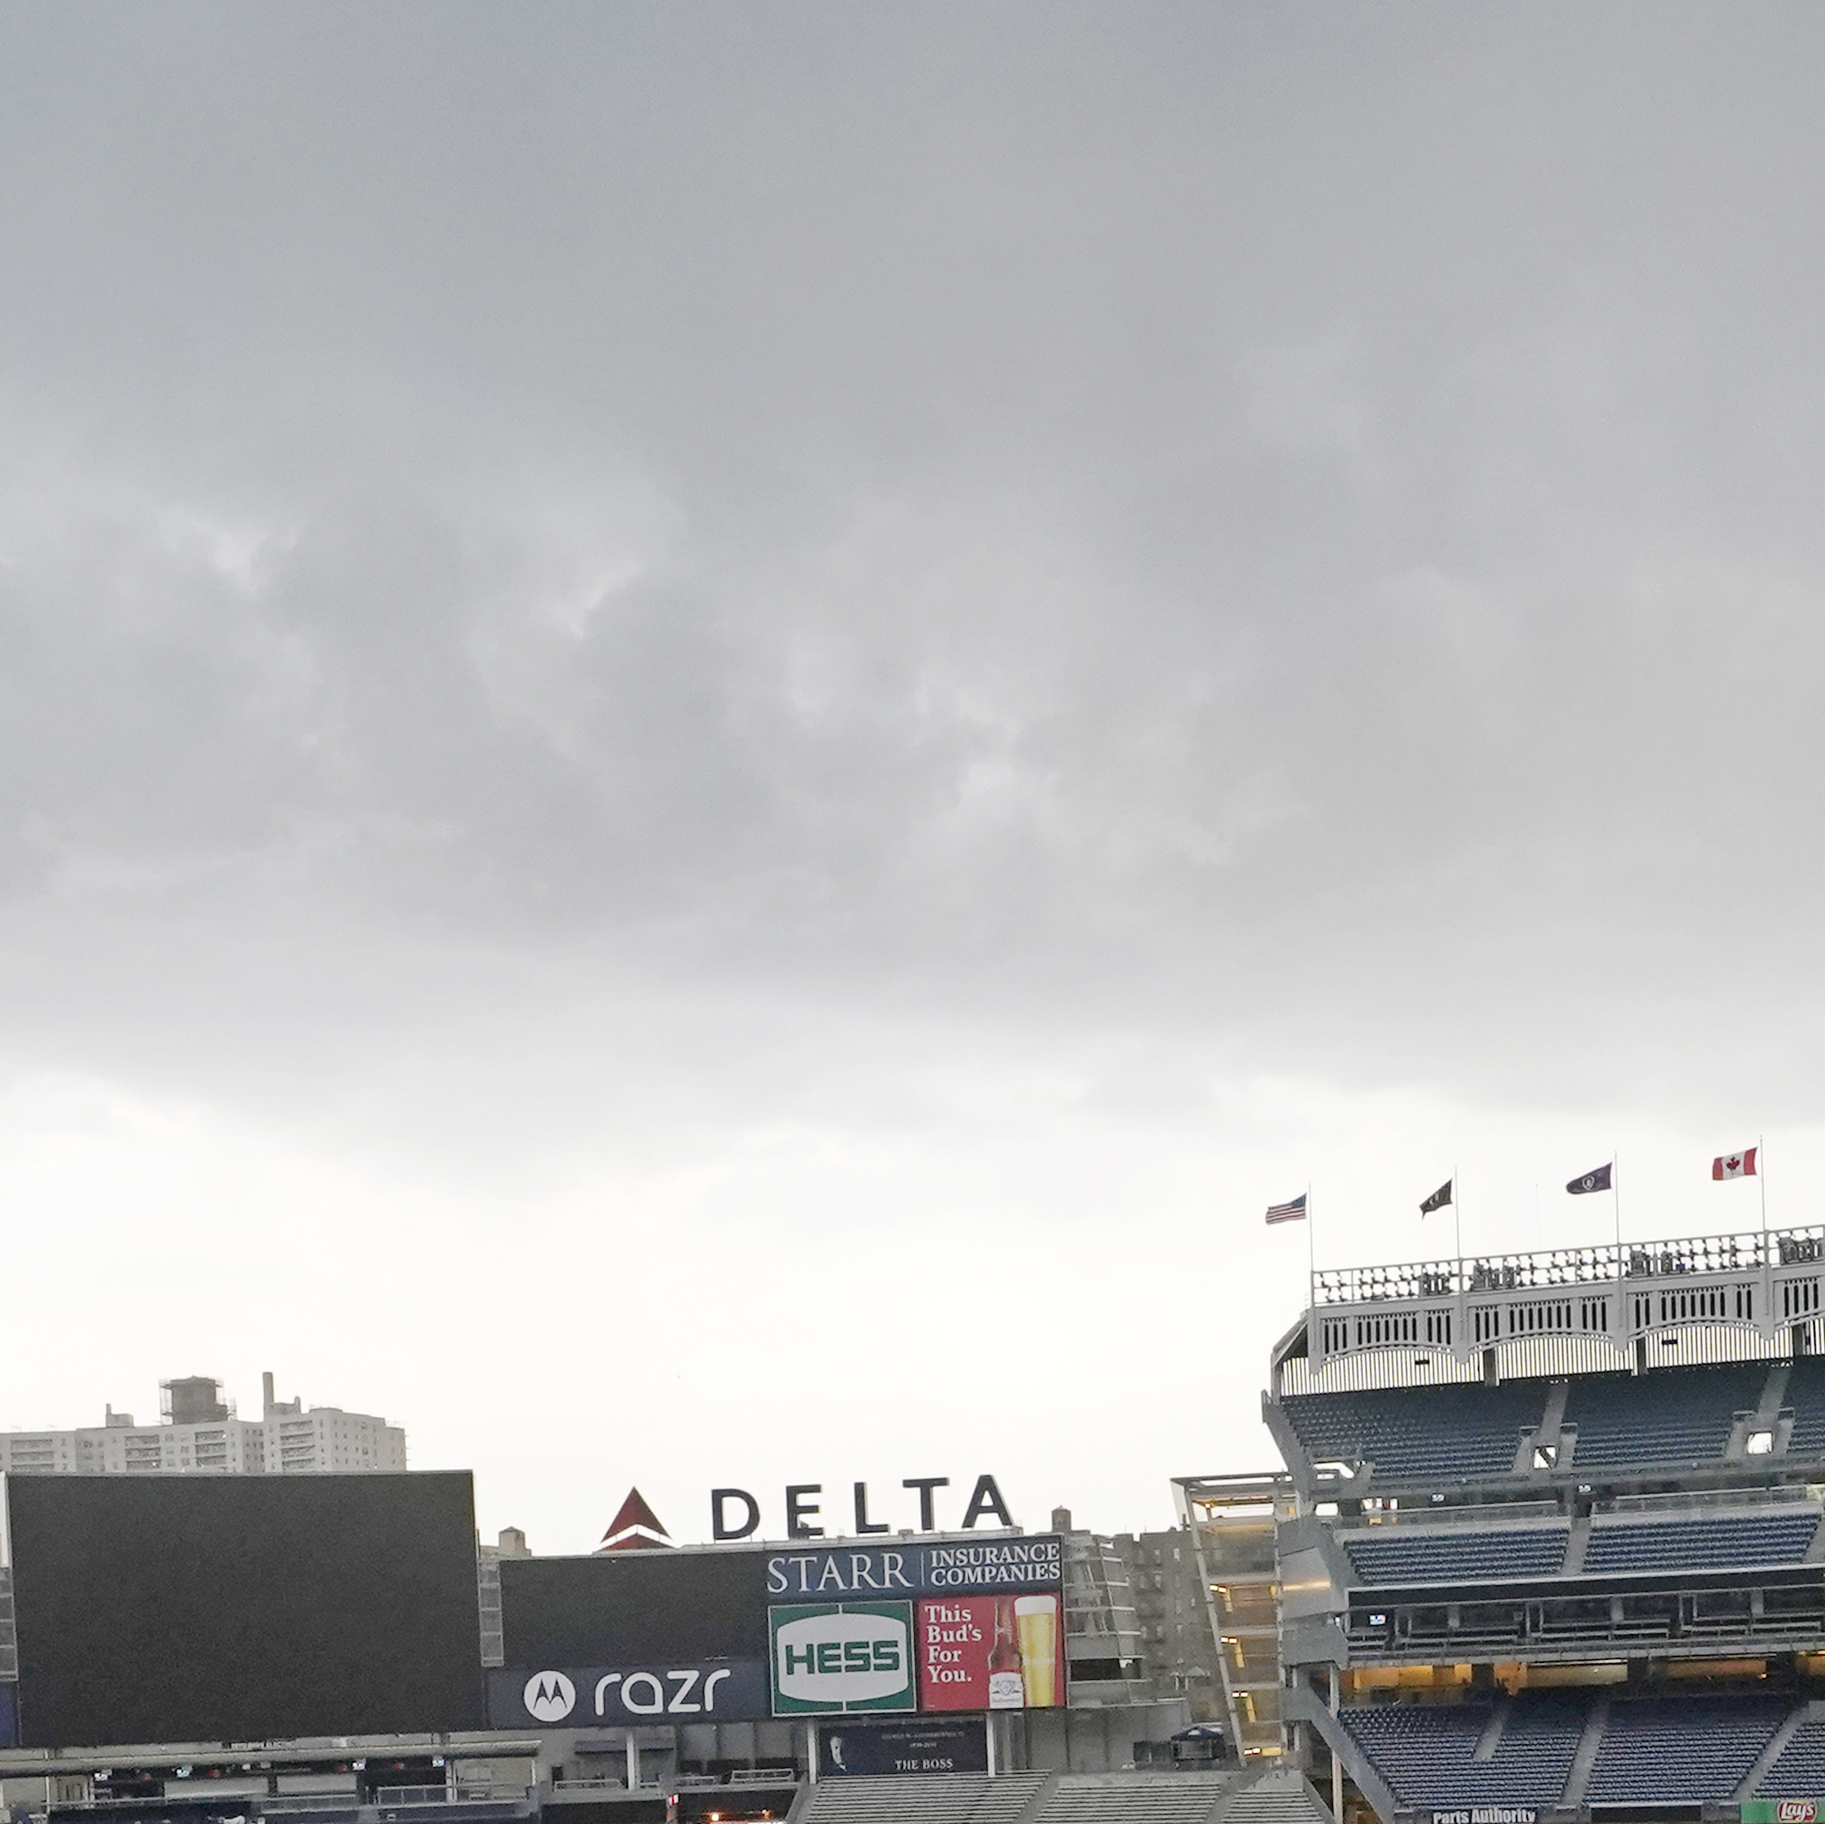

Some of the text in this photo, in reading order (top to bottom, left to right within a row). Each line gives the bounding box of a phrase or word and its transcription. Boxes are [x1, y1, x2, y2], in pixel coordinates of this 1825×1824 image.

[710, 1474, 1014, 1541] DELTA
[930, 1542, 1060, 1569] INSURANCE
[766, 1551, 915, 1594] STARR
[930, 1561, 1061, 1587] COMPANIES
[925, 1604, 972, 1625] This
[926, 1624, 983, 1645] Bud's
[785, 1639, 900, 1675] HESS
[927, 1645, 962, 1664] For
[927, 1664, 973, 1685] You.
[594, 1668, 731, 1716] razr
[895, 1757, 954, 1770] THE BOSS
[1471, 1806, 1536, 1824] Authority
